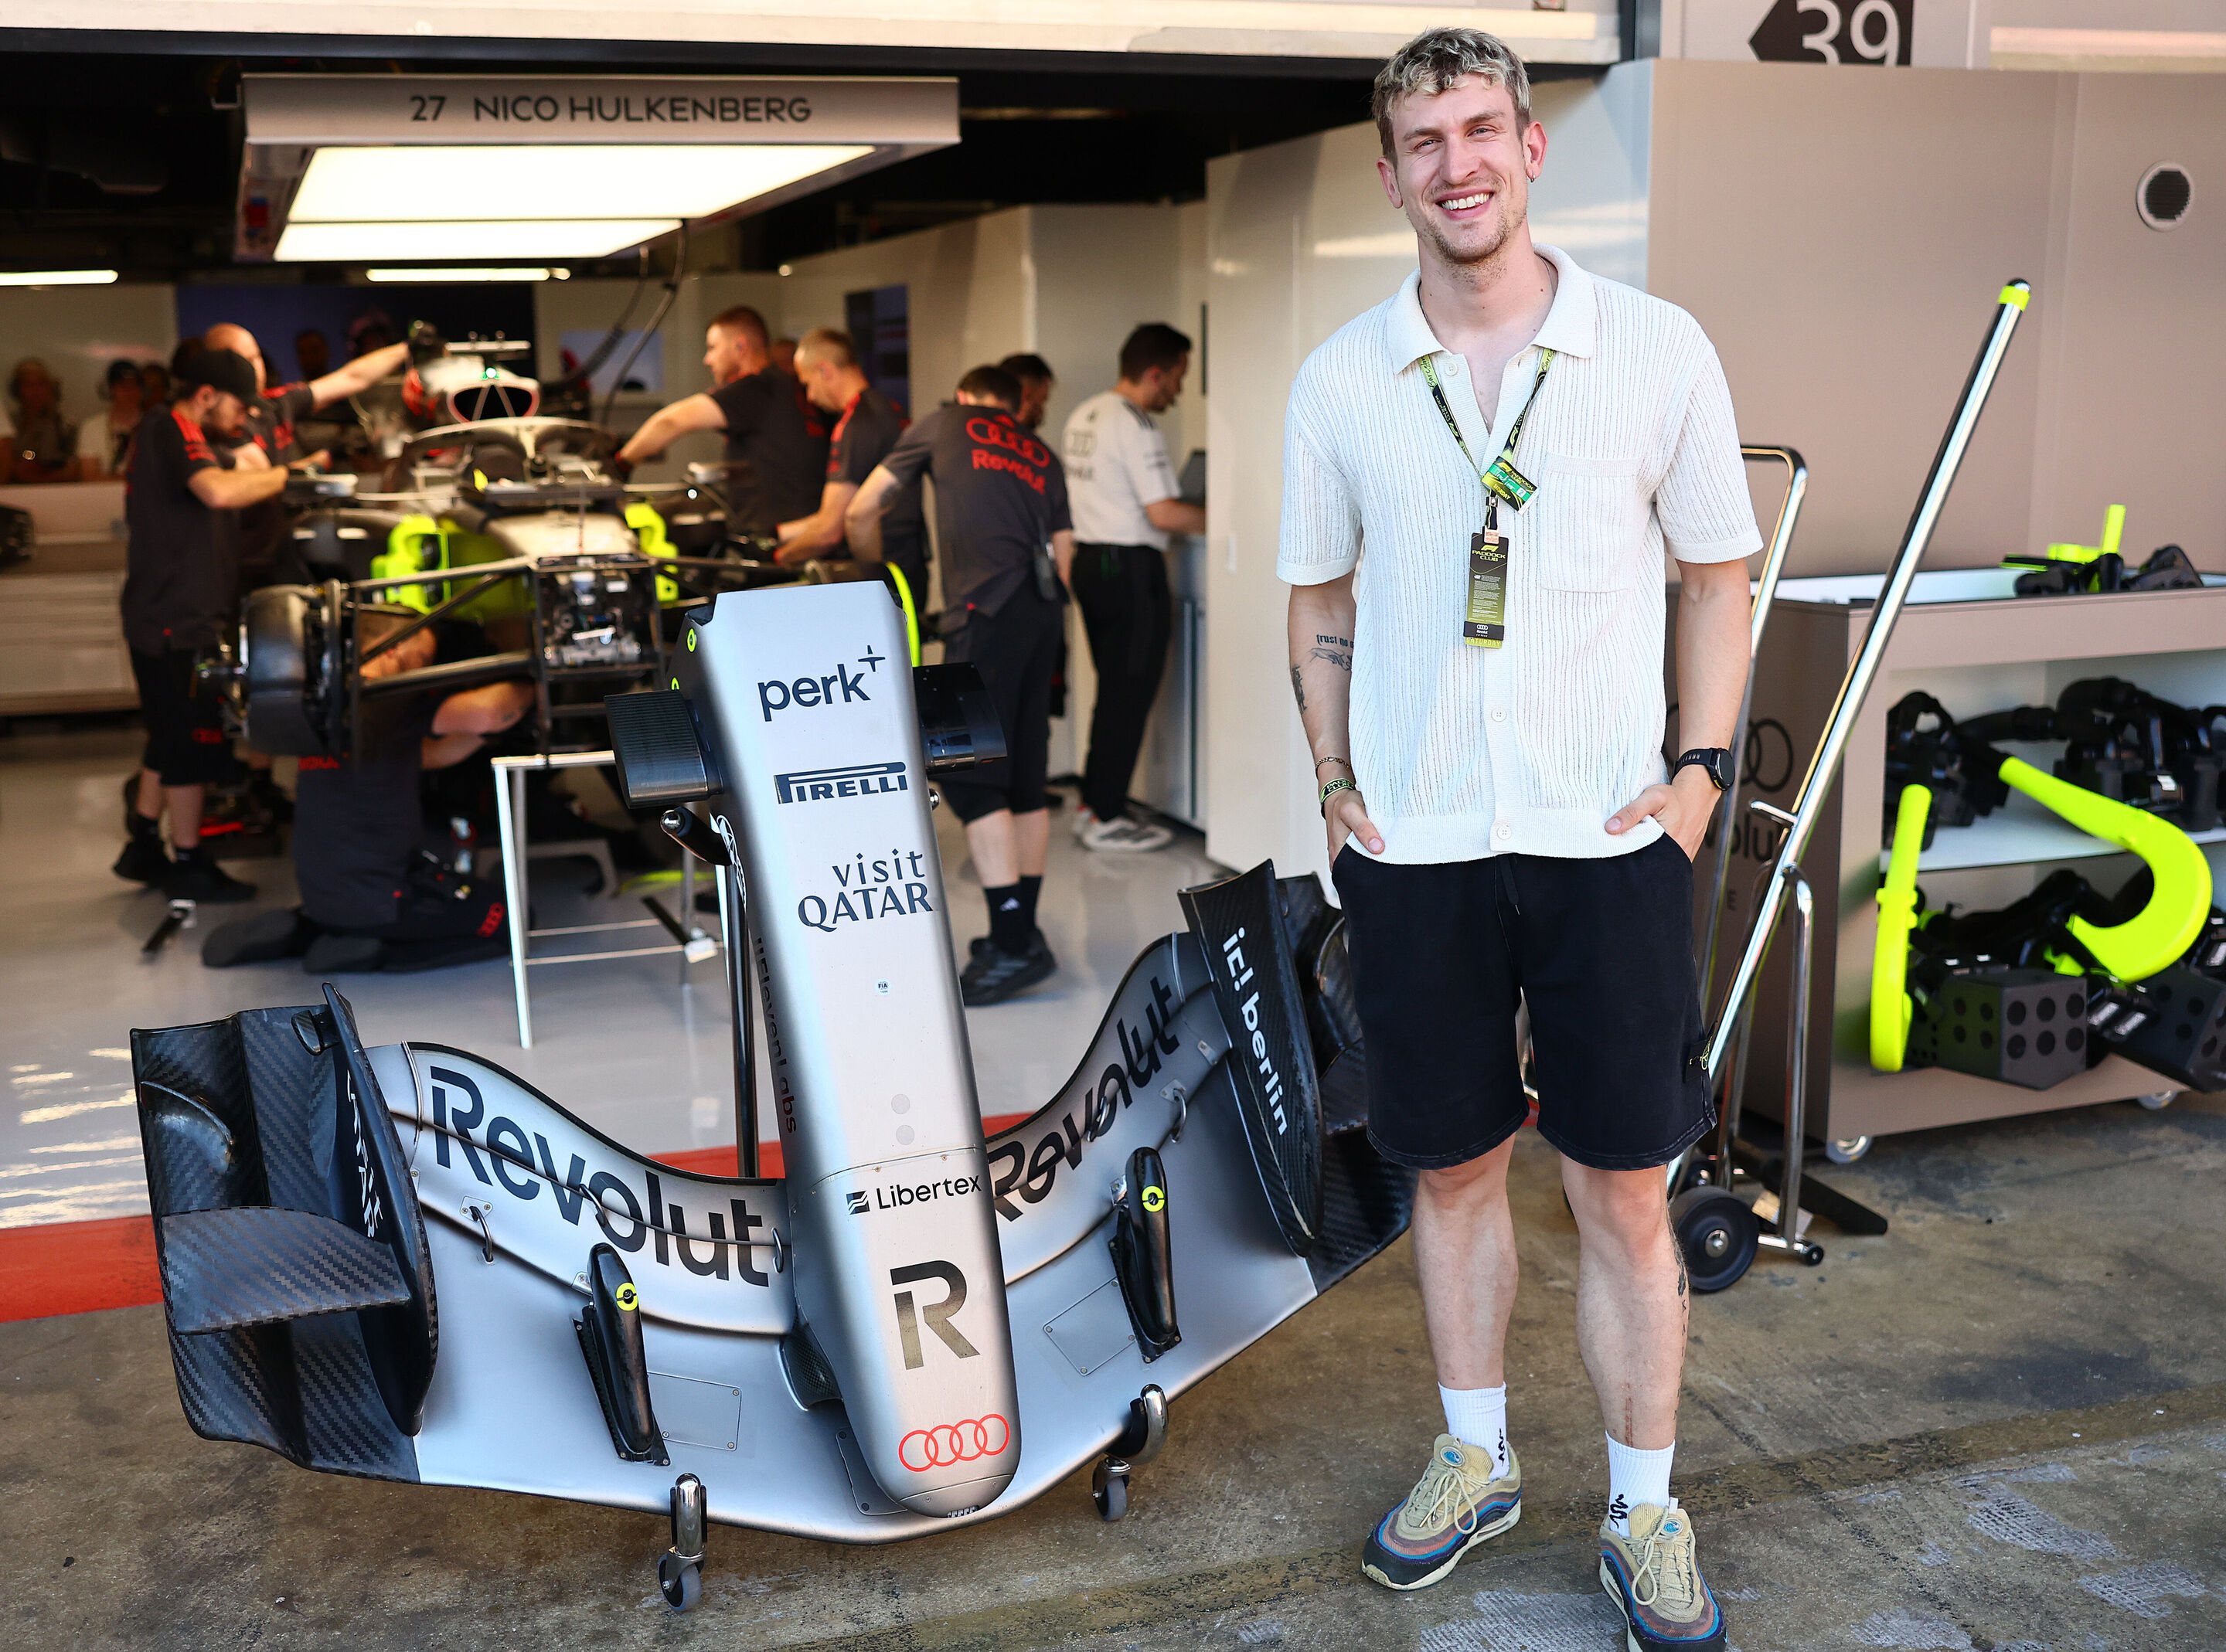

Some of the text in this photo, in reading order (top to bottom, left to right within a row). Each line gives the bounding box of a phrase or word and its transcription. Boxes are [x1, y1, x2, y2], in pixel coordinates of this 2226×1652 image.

[1796, 0, 1900, 66] 39
[410, 95, 812, 123] 27 NICO HULKENBERG
[1472, 549, 1506, 559] PADDOCK
[1465, 637, 1501, 648] SATURDAY
[757, 663, 871, 722] perk
[773, 761, 908, 804] PIRELLI
[832, 848, 926, 888] visit
[798, 882, 934, 933] QATAR
[1241, 991, 1288, 1137] berlin
[988, 976, 1180, 1222] Revolut
[430, 1066, 769, 1288] Revolut
[876, 1174, 982, 1210] Libertex
[890, 1259, 981, 1371] R
